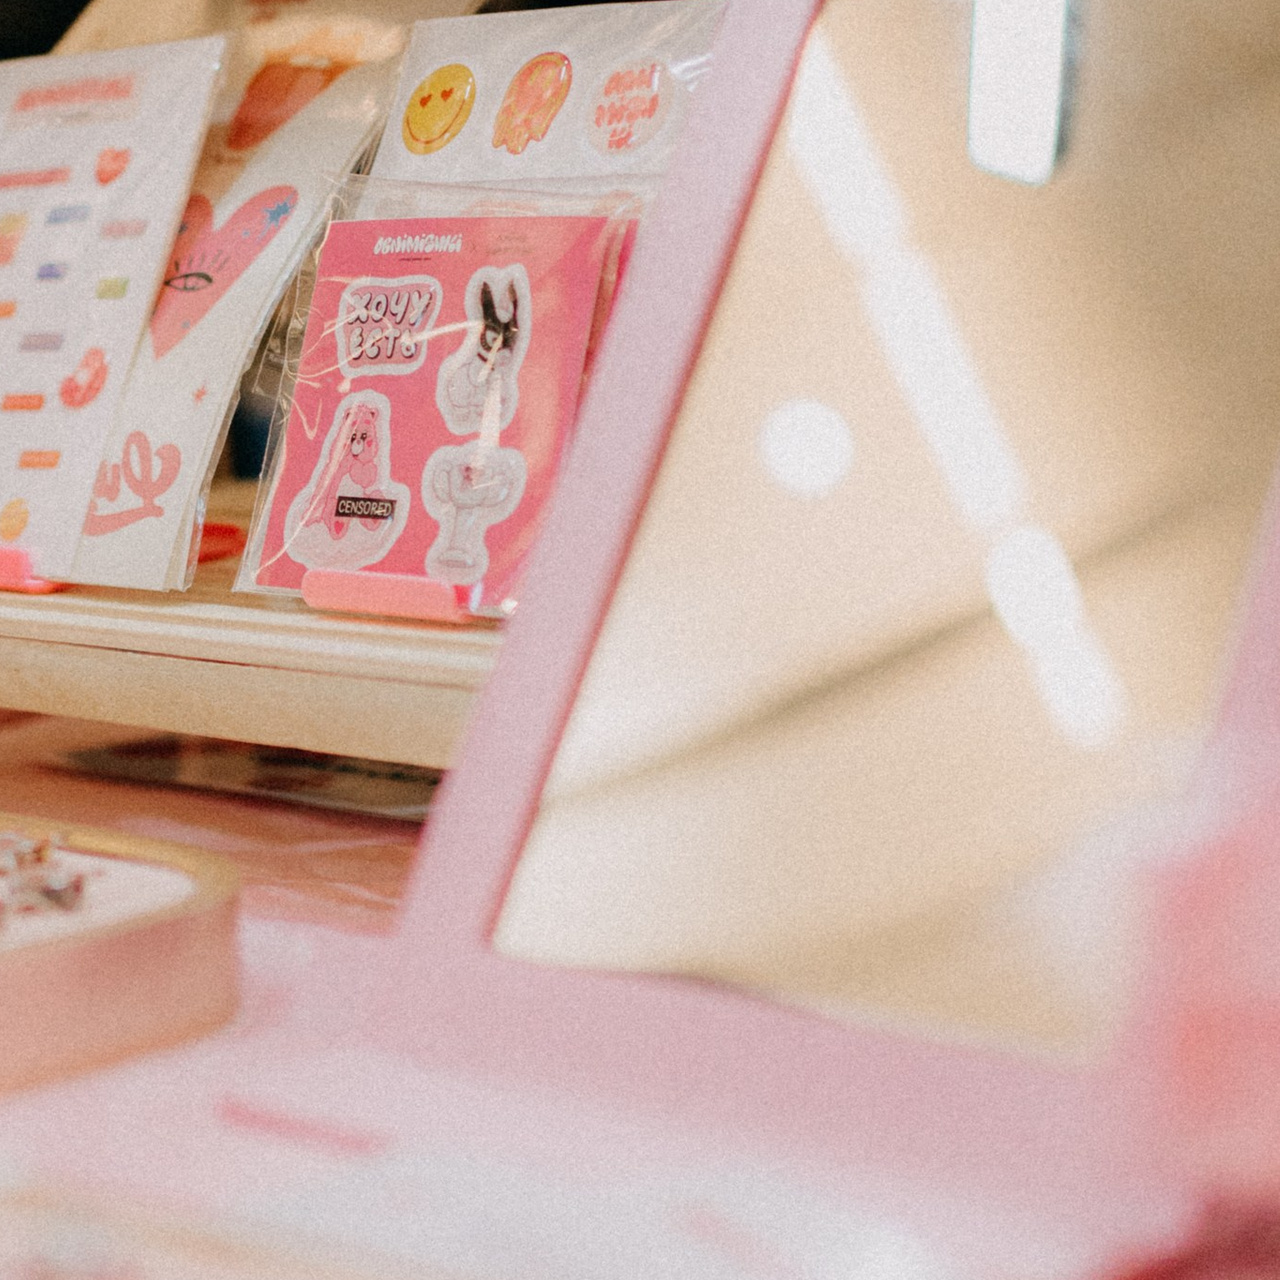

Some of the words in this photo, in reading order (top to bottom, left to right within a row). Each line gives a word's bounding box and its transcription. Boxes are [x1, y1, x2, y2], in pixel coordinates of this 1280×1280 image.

[346, 289, 433, 326] ХОЧУ
[349, 325, 418, 361] ЕСТЬ
[338, 499, 393, 517] CENSORED
